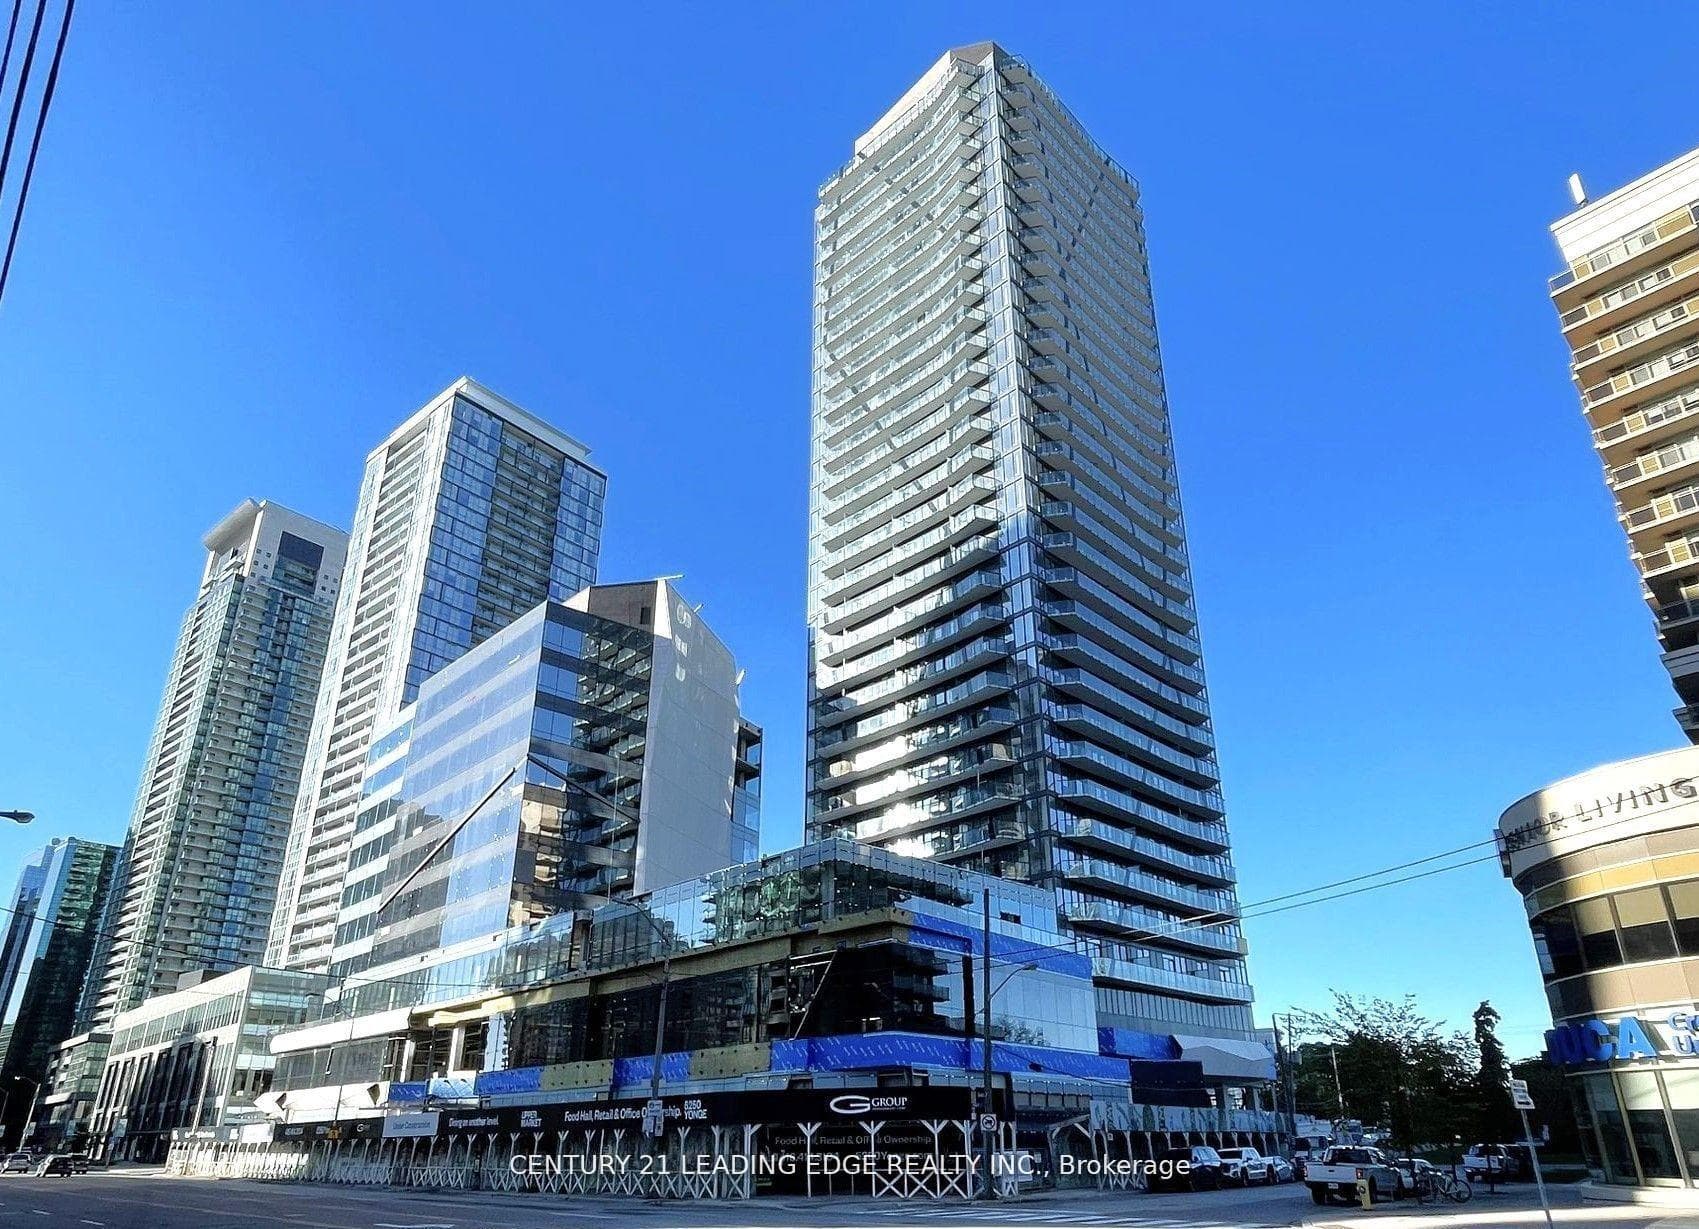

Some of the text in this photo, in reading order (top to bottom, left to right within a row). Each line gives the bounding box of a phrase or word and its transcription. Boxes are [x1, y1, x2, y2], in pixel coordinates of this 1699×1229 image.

[1575, 778, 1698, 822] LIVING
[871, 1096, 908, 1107] GROUP
[564, 1111, 580, 1122] Food
[594, 1109, 613, 1120] Retail
[613, 1108, 620, 1119] &
[620, 1107, 641, 1119] Office
[684, 1109, 708, 1120] YONGE
[520, 1118, 542, 1128] MARKET
[775, 1136, 797, 1145] Food
[820, 1136, 846, 1145] Retail
[883, 1135, 932, 1146] Ownership
